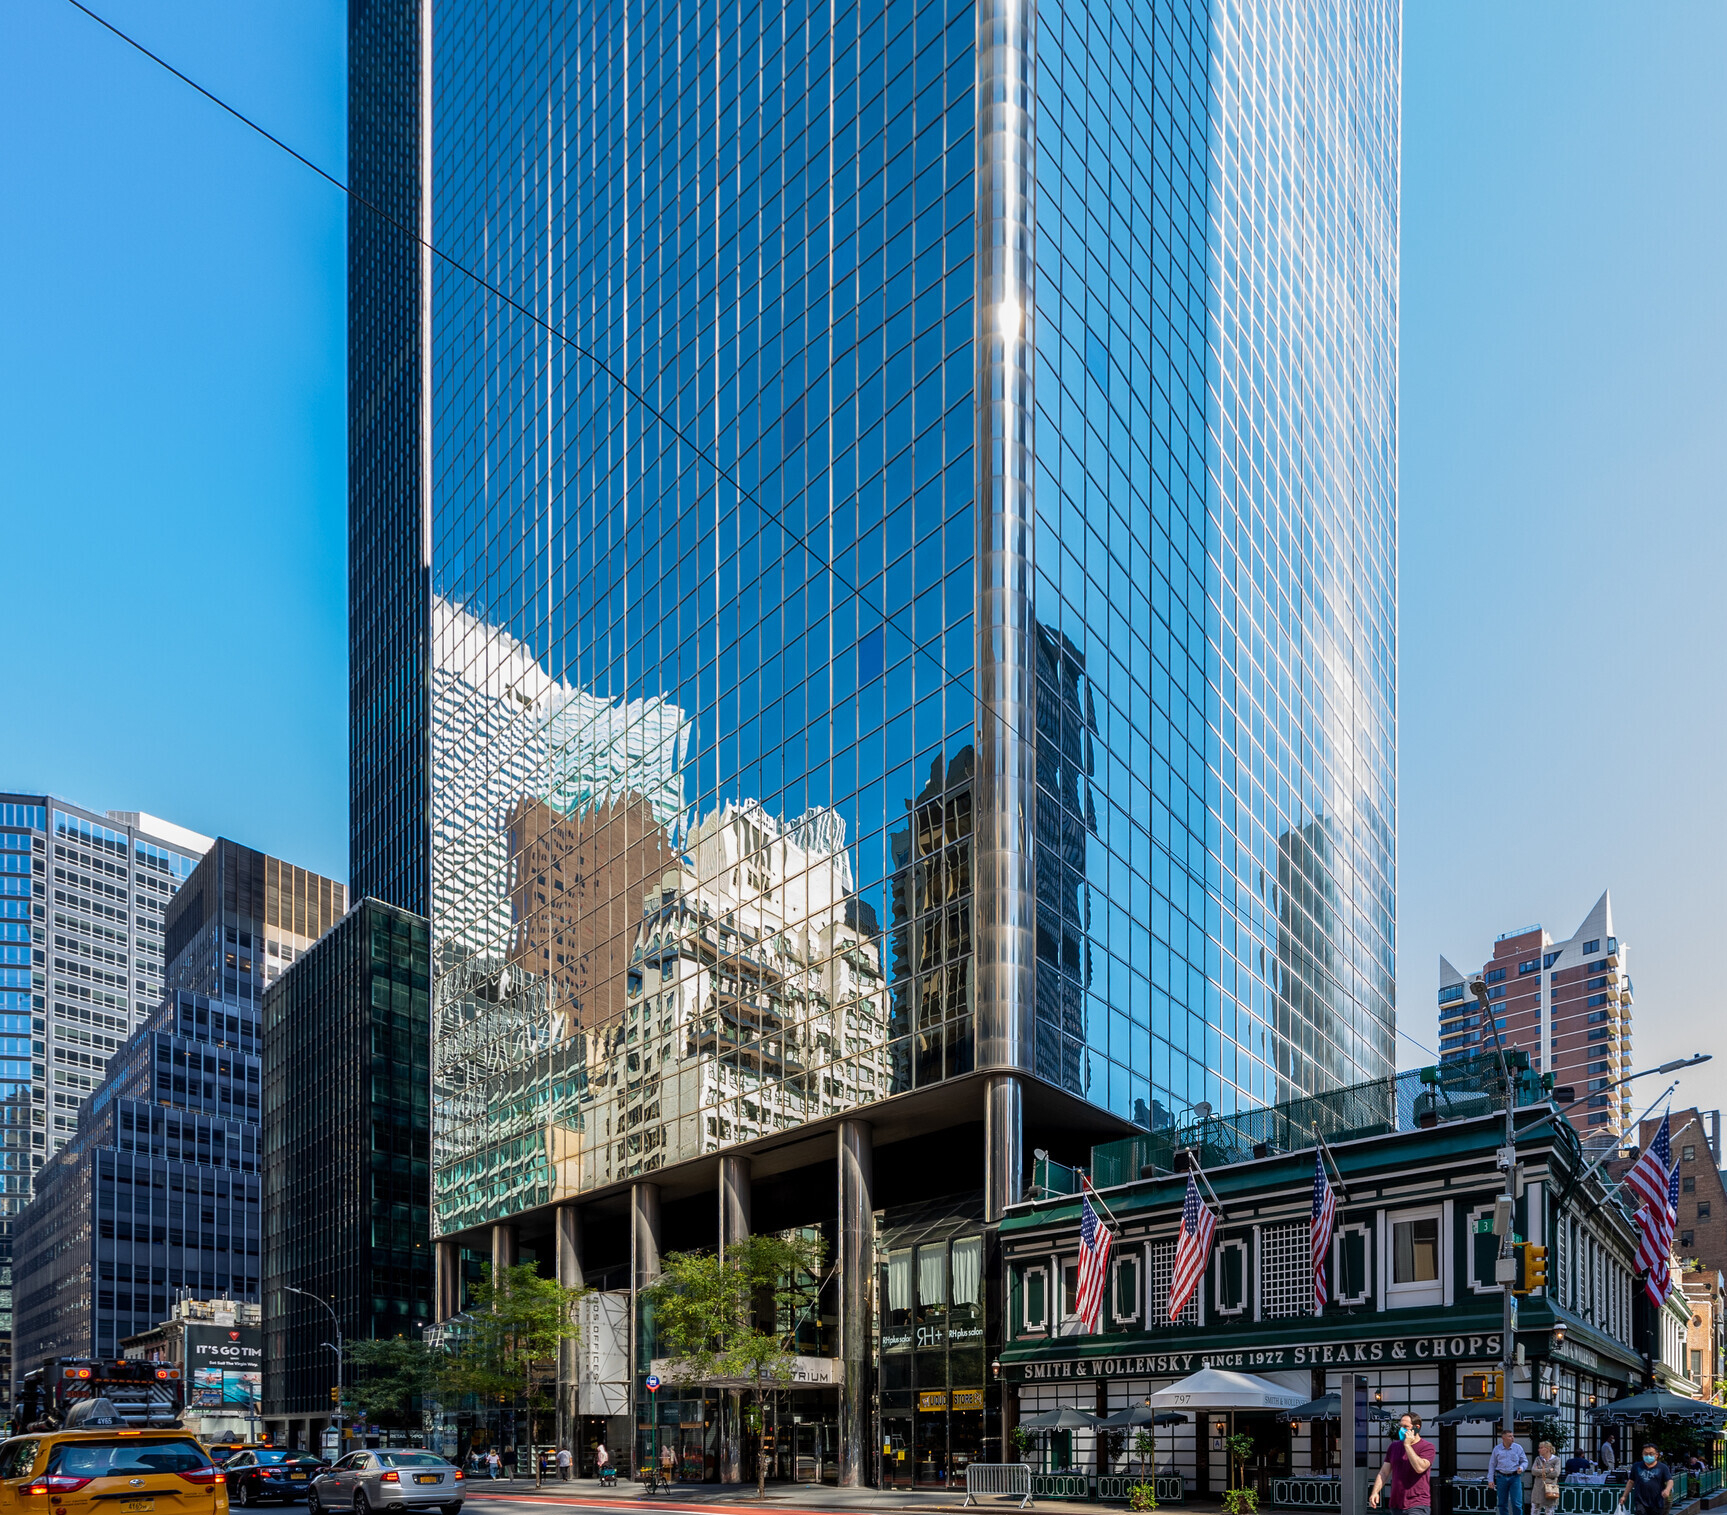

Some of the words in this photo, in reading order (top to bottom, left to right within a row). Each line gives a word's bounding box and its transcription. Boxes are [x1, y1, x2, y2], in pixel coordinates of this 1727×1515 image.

[957, 1327, 967, 1339] plus
[968, 1326, 983, 1337] salon
[196, 1345, 219, 1355] IT'S
[220, 1346, 240, 1356] GO
[241, 1347, 262, 1357] TIM
[1024, 1362, 1072, 1379] SMITH
[1076, 1361, 1087, 1376] &
[1092, 1354, 1194, 1375] WOLLENSKY
[1201, 1354, 1243, 1367] SINCE
[1249, 1351, 1285, 1365] 1977
[1294, 1342, 1384, 1364] STEAKS
[1391, 1341, 1407, 1359] &
[1415, 1335, 1501, 1358] CHOPS
[790, 1371, 829, 1382] TRIUM
[930, 1394, 948, 1406] LIQUO
[954, 1393, 973, 1405] STORE
[1174, 1395, 1191, 1405] 797
[1264, 1395, 1279, 1405] SMITH
[97, 1417, 113, 1425] 4Y65
